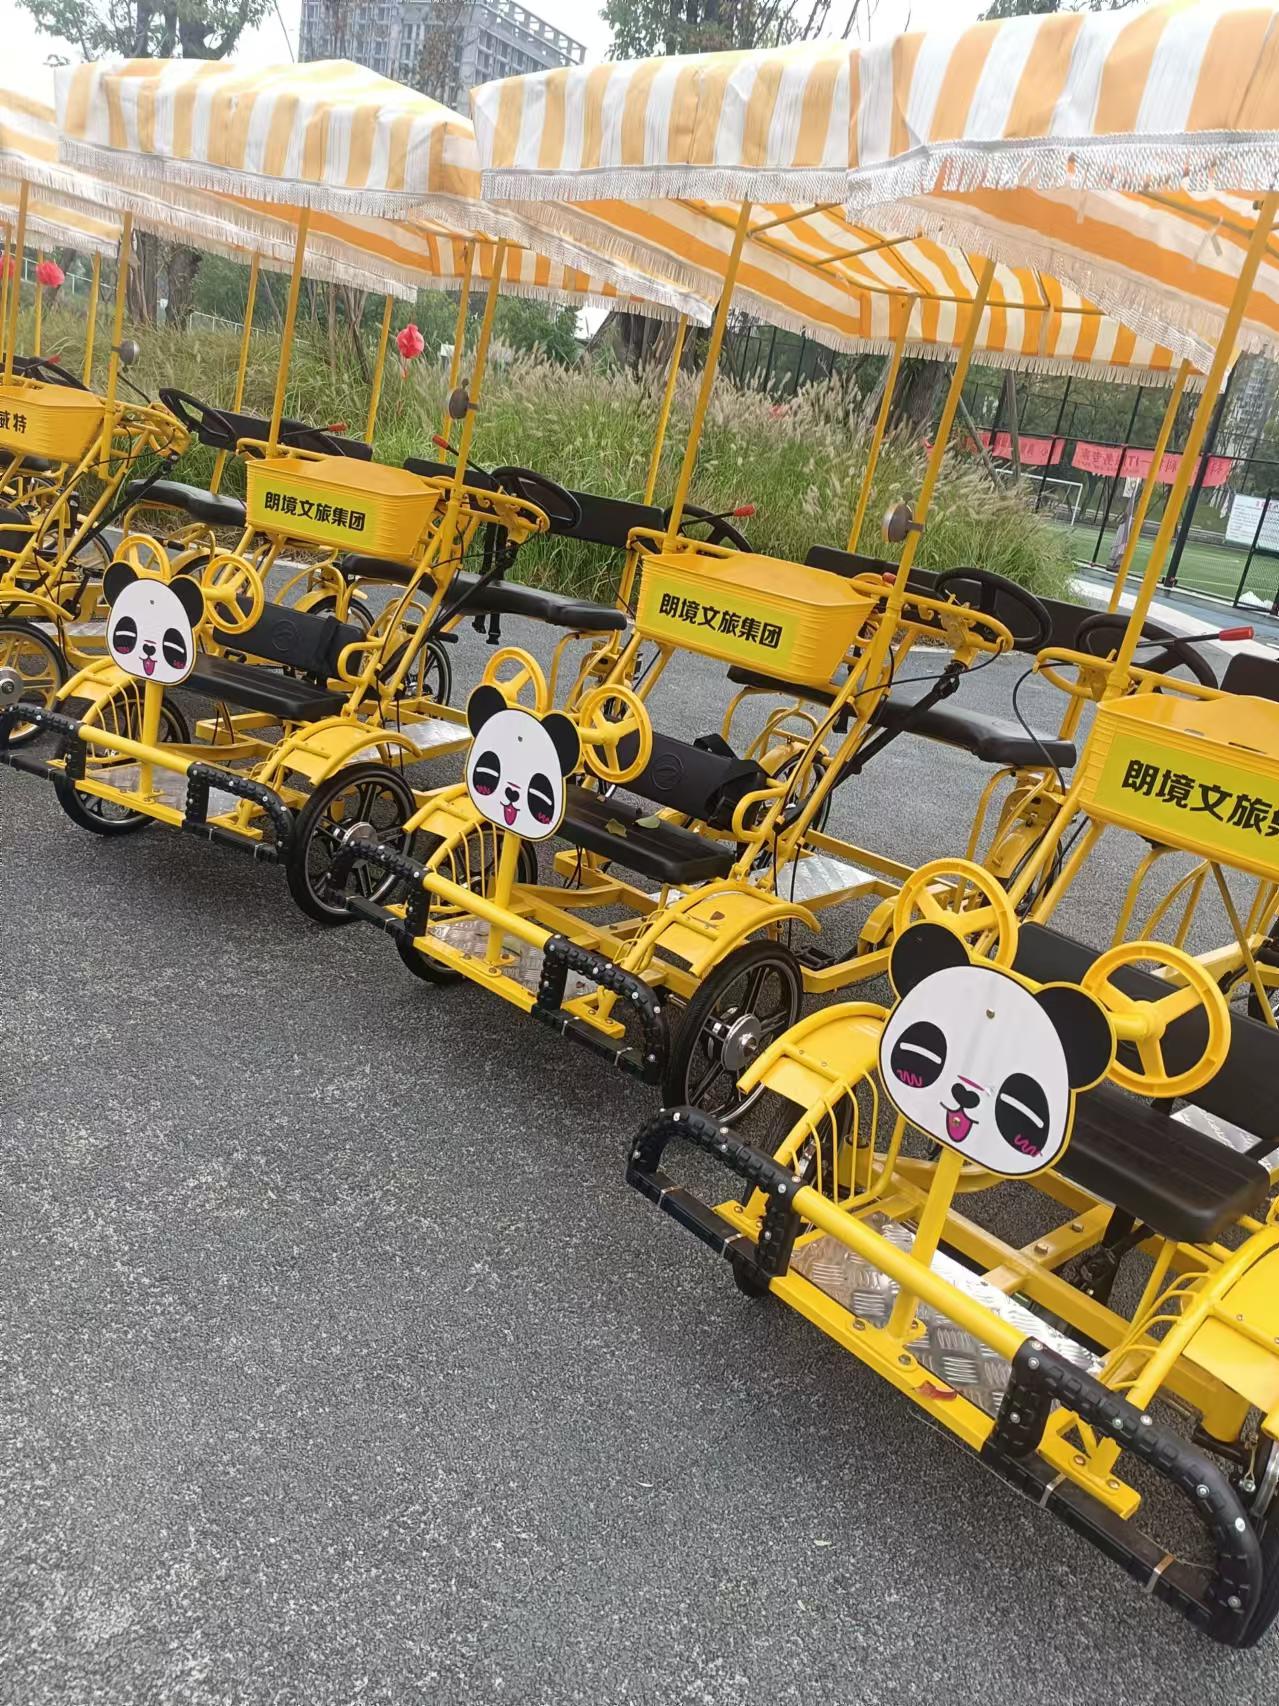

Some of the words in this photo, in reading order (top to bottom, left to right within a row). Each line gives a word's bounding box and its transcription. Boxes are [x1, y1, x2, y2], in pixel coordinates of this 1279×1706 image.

[264, 491, 366, 532] 朗境文旅集团
[659, 593, 783, 649] 朗境文旅集团
